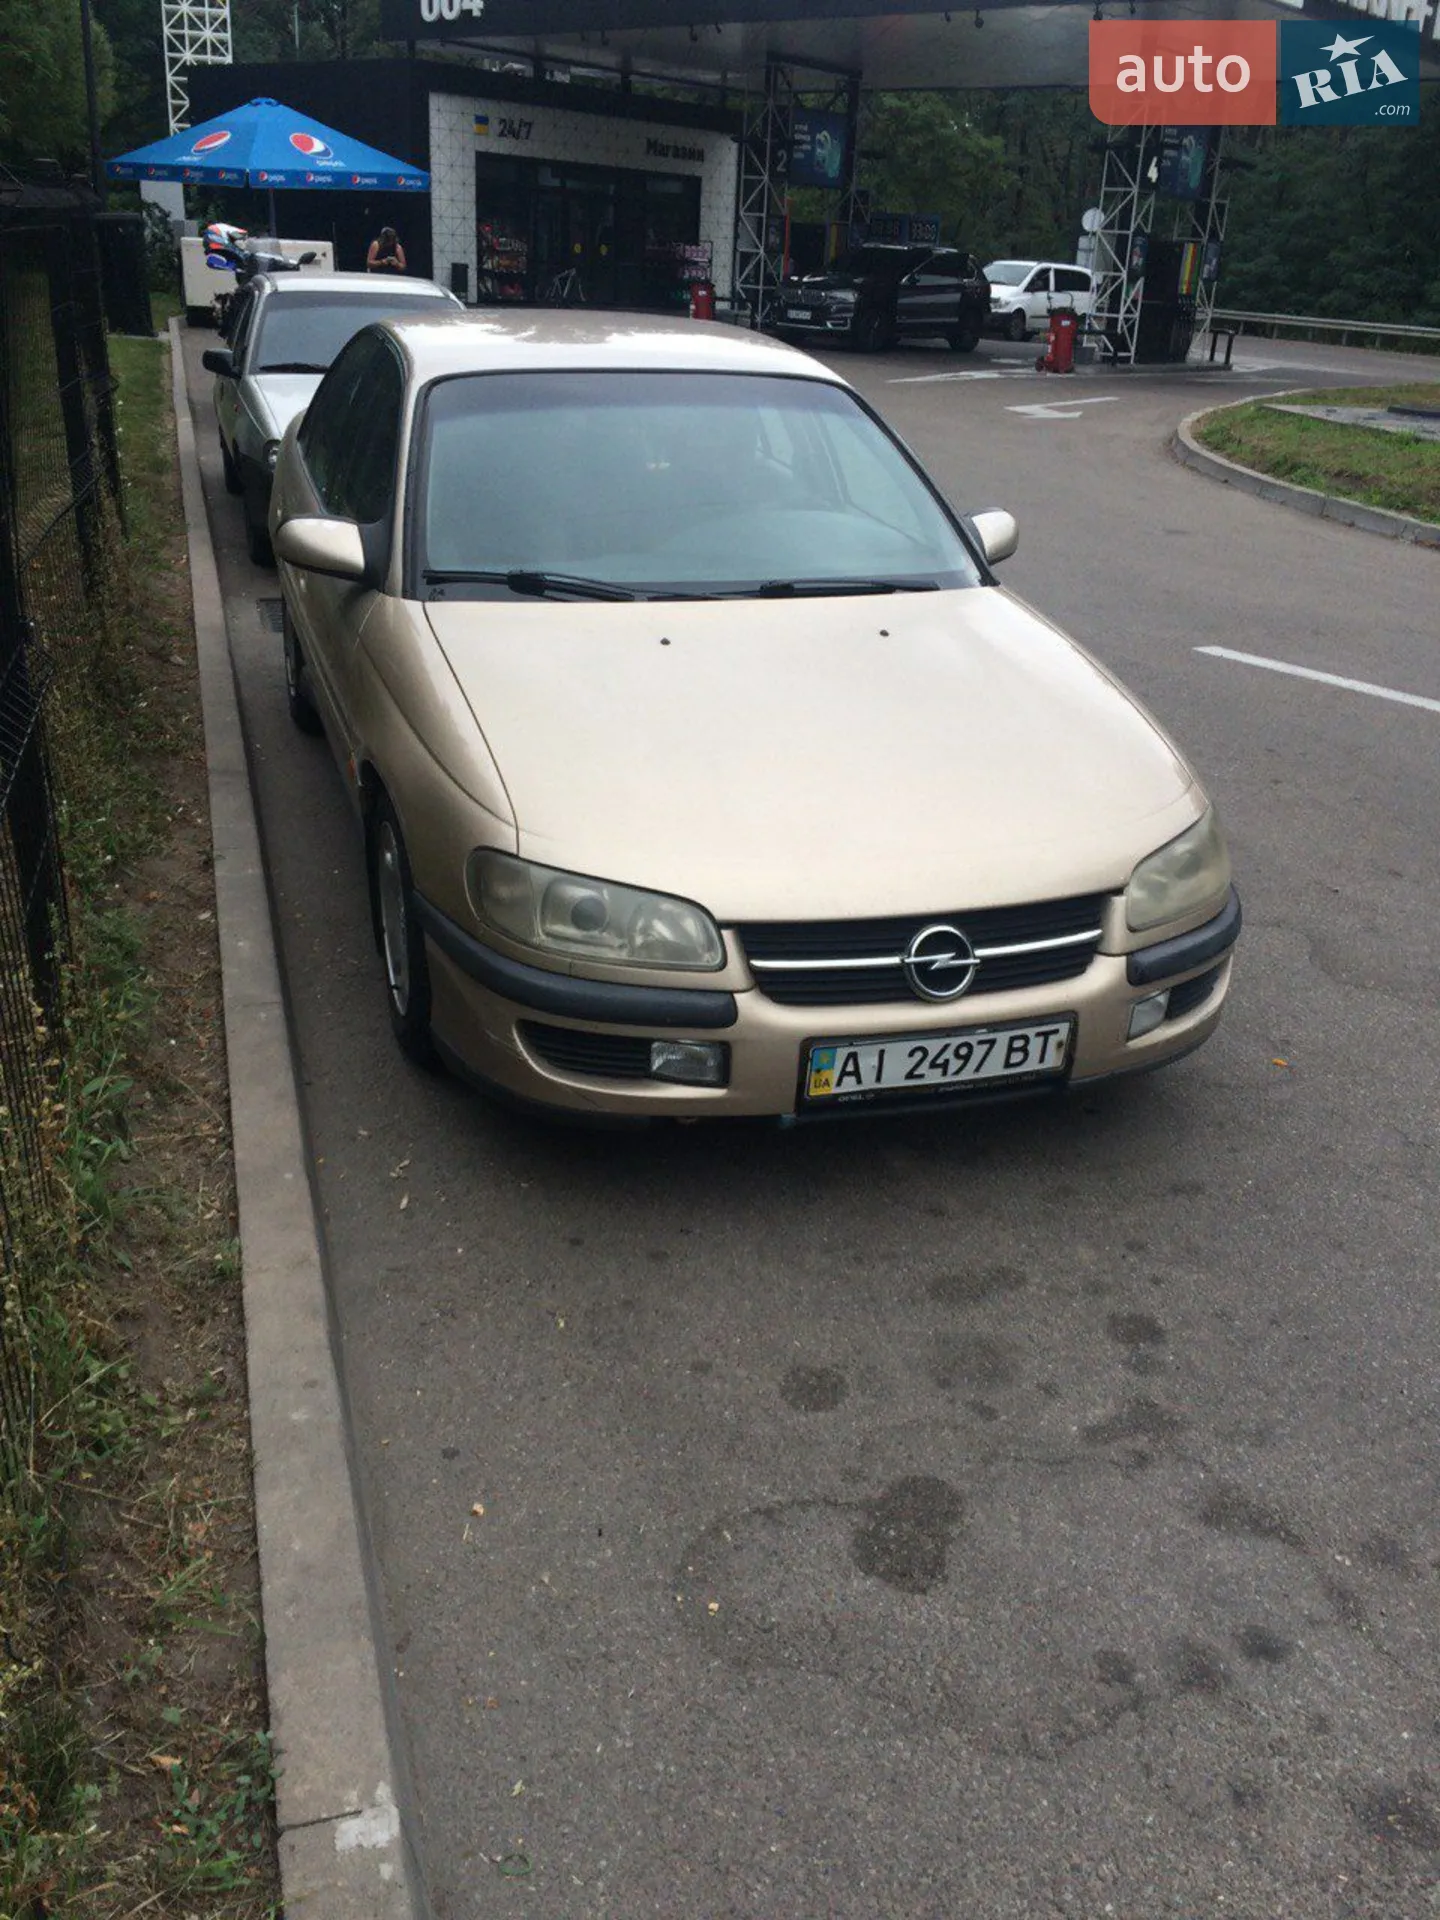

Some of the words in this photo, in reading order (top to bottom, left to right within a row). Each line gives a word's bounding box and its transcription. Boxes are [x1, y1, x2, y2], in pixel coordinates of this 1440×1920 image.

[496, 118, 534, 140] 24/7
[776, 149, 788, 172] 2
[835, 1049, 885, 1088] AI
[904, 1037, 998, 1081] 2497
[1003, 1028, 1060, 1069] BT
[813, 1077, 831, 1089] UA
